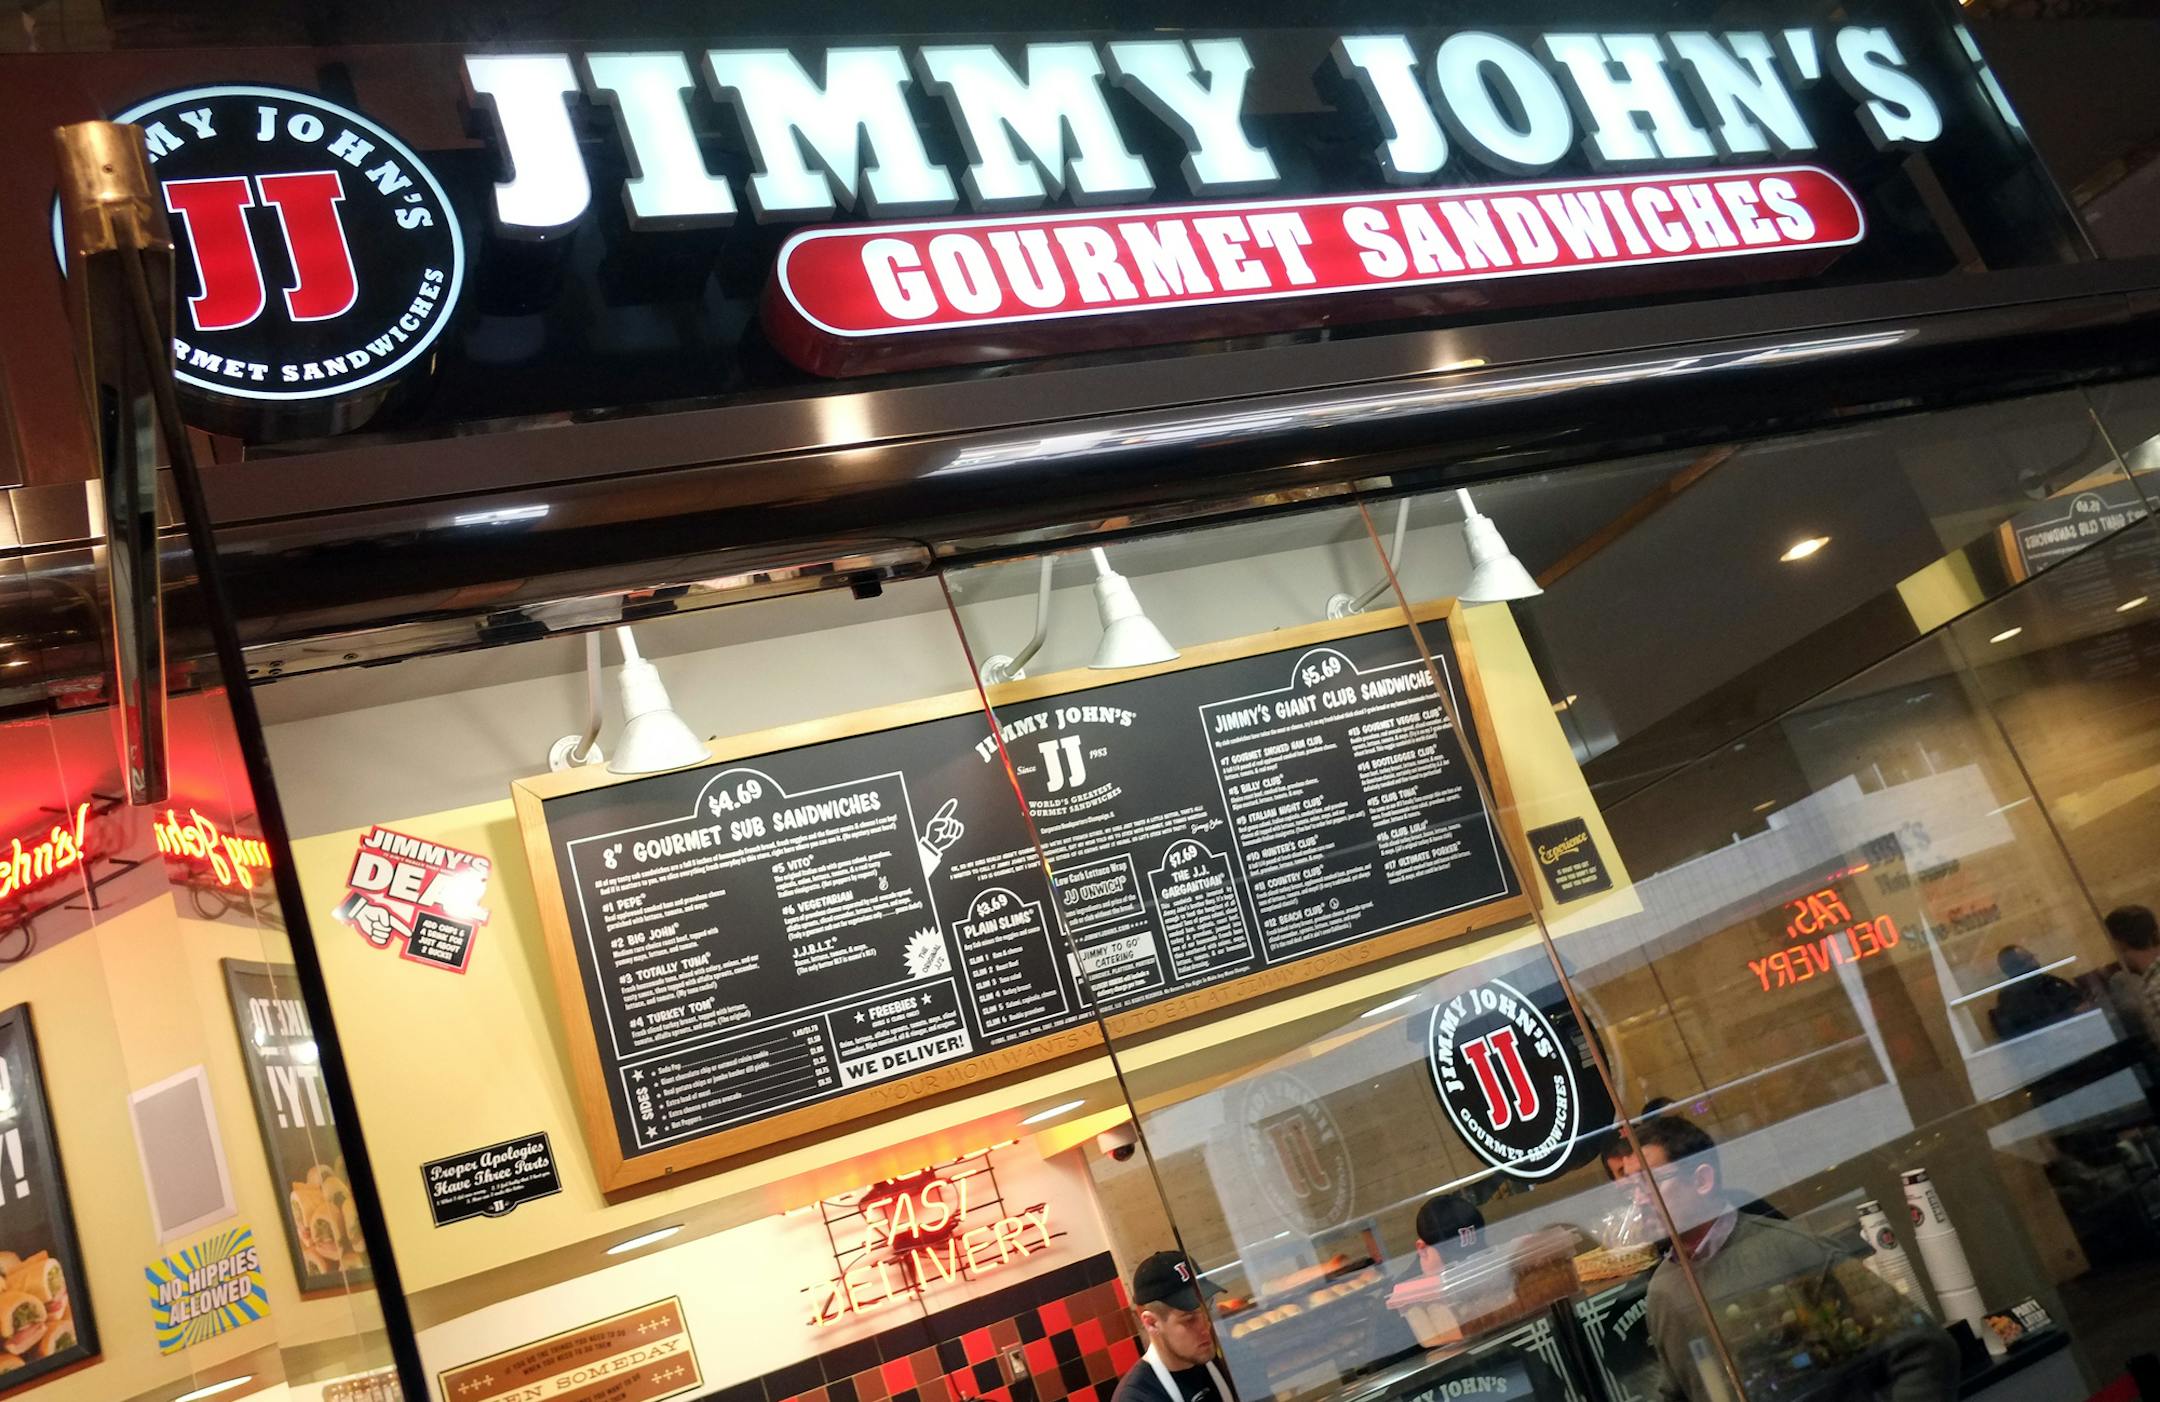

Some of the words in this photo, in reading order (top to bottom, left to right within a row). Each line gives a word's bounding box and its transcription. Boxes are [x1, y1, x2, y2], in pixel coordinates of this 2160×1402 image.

[462, 38, 1282, 230] JIMMY
[1339, 27, 1942, 174] JOHN'S
[257, 106, 433, 232] JOHN'S
[166, 170, 344, 331] JJ
[861, 213, 1313, 321] GOURMET
[1342, 178, 1815, 279] SANDWICHES
[172, 337, 267, 382] RMET
[281, 267, 444, 382] SANDWICHES
[1301, 656, 1342, 688] $5.69
[1215, 704, 1271, 733] JIMMY'S
[1275, 694, 1316, 719] GIANT
[1322, 687, 1357, 709] CLUB
[1361, 670, 1434, 700] SANDWICHE
[975, 712, 1049, 763] JIMMY
[1056, 707, 1132, 730] JOHN'S
[1017, 766, 1036, 775] Since
[1089, 747, 1107, 759] 1983
[1038, 734, 1087, 793] JJ
[709, 779, 763, 818] $4.69
[1028, 797, 1070, 809] WORLD'S
[1071, 783, 1115, 803] GREATEST
[1028, 806, 1067, 818] OURMET
[1065, 787, 1122, 813] SANDWICHES
[633, 825, 722, 862] GOURMET
[730, 816, 766, 841] SUB
[773, 791, 881, 832] SANDWICHES
[365, 829, 489, 871] JIMMY'S
[1169, 846, 1198, 869] $7.69
[1538, 832, 1588, 865] Experience
[351, 852, 489, 922] DEA
[1054, 877, 1069, 887] Low
[1069, 871, 1085, 883] Carb
[1084, 867, 1111, 879] Lettuce
[1110, 862, 1127, 872] Wrap
[1171, 869, 1190, 883] THE
[797, 890, 854, 912] VEGETARIAN
[976, 894, 1008, 918] $3.69
[627, 932, 645, 945] BIG
[963, 919, 998, 939] PLAIN
[635, 961, 678, 980] TOTALLY
[1083, 947, 1107, 961] JIMMY
[1111, 942, 1122, 952] TO
[1095, 950, 1134, 968] CATERING
[646, 1005, 685, 1024] TURKEY
[868, 997, 917, 1020] FREEBIES
[846, 1060, 878, 1079] WE
[882, 1035, 964, 1070] DELIVER!
[1438, 996, 1467, 1092] JIMMY
[1469, 988, 1552, 1058] JOHN'S
[1459, 1025, 1540, 1131] JJ
[636, 1087, 654, 1120] SIDES
[1460, 1107, 1524, 1161] GOURMET
[1527, 1075, 1567, 1162] SANDWICHES
[431, 1161, 481, 1184] Proper
[480, 1143, 544, 1172] Apologies
[434, 1175, 471, 1197] Have
[474, 1165, 512, 1185] Three
[514, 1157, 549, 1175] Parts
[865, 1170, 977, 1254] FAST
[159, 1278, 182, 1305] NO
[188, 1247, 258, 1294] HIPPIES
[808, 1204, 1051, 1327] DELIVERY
[169, 1276, 251, 1327] ALLOWED
[556, 1339, 680, 1390] SOMEDAY
[1439, 1375, 1507, 1397] JOHN'S
